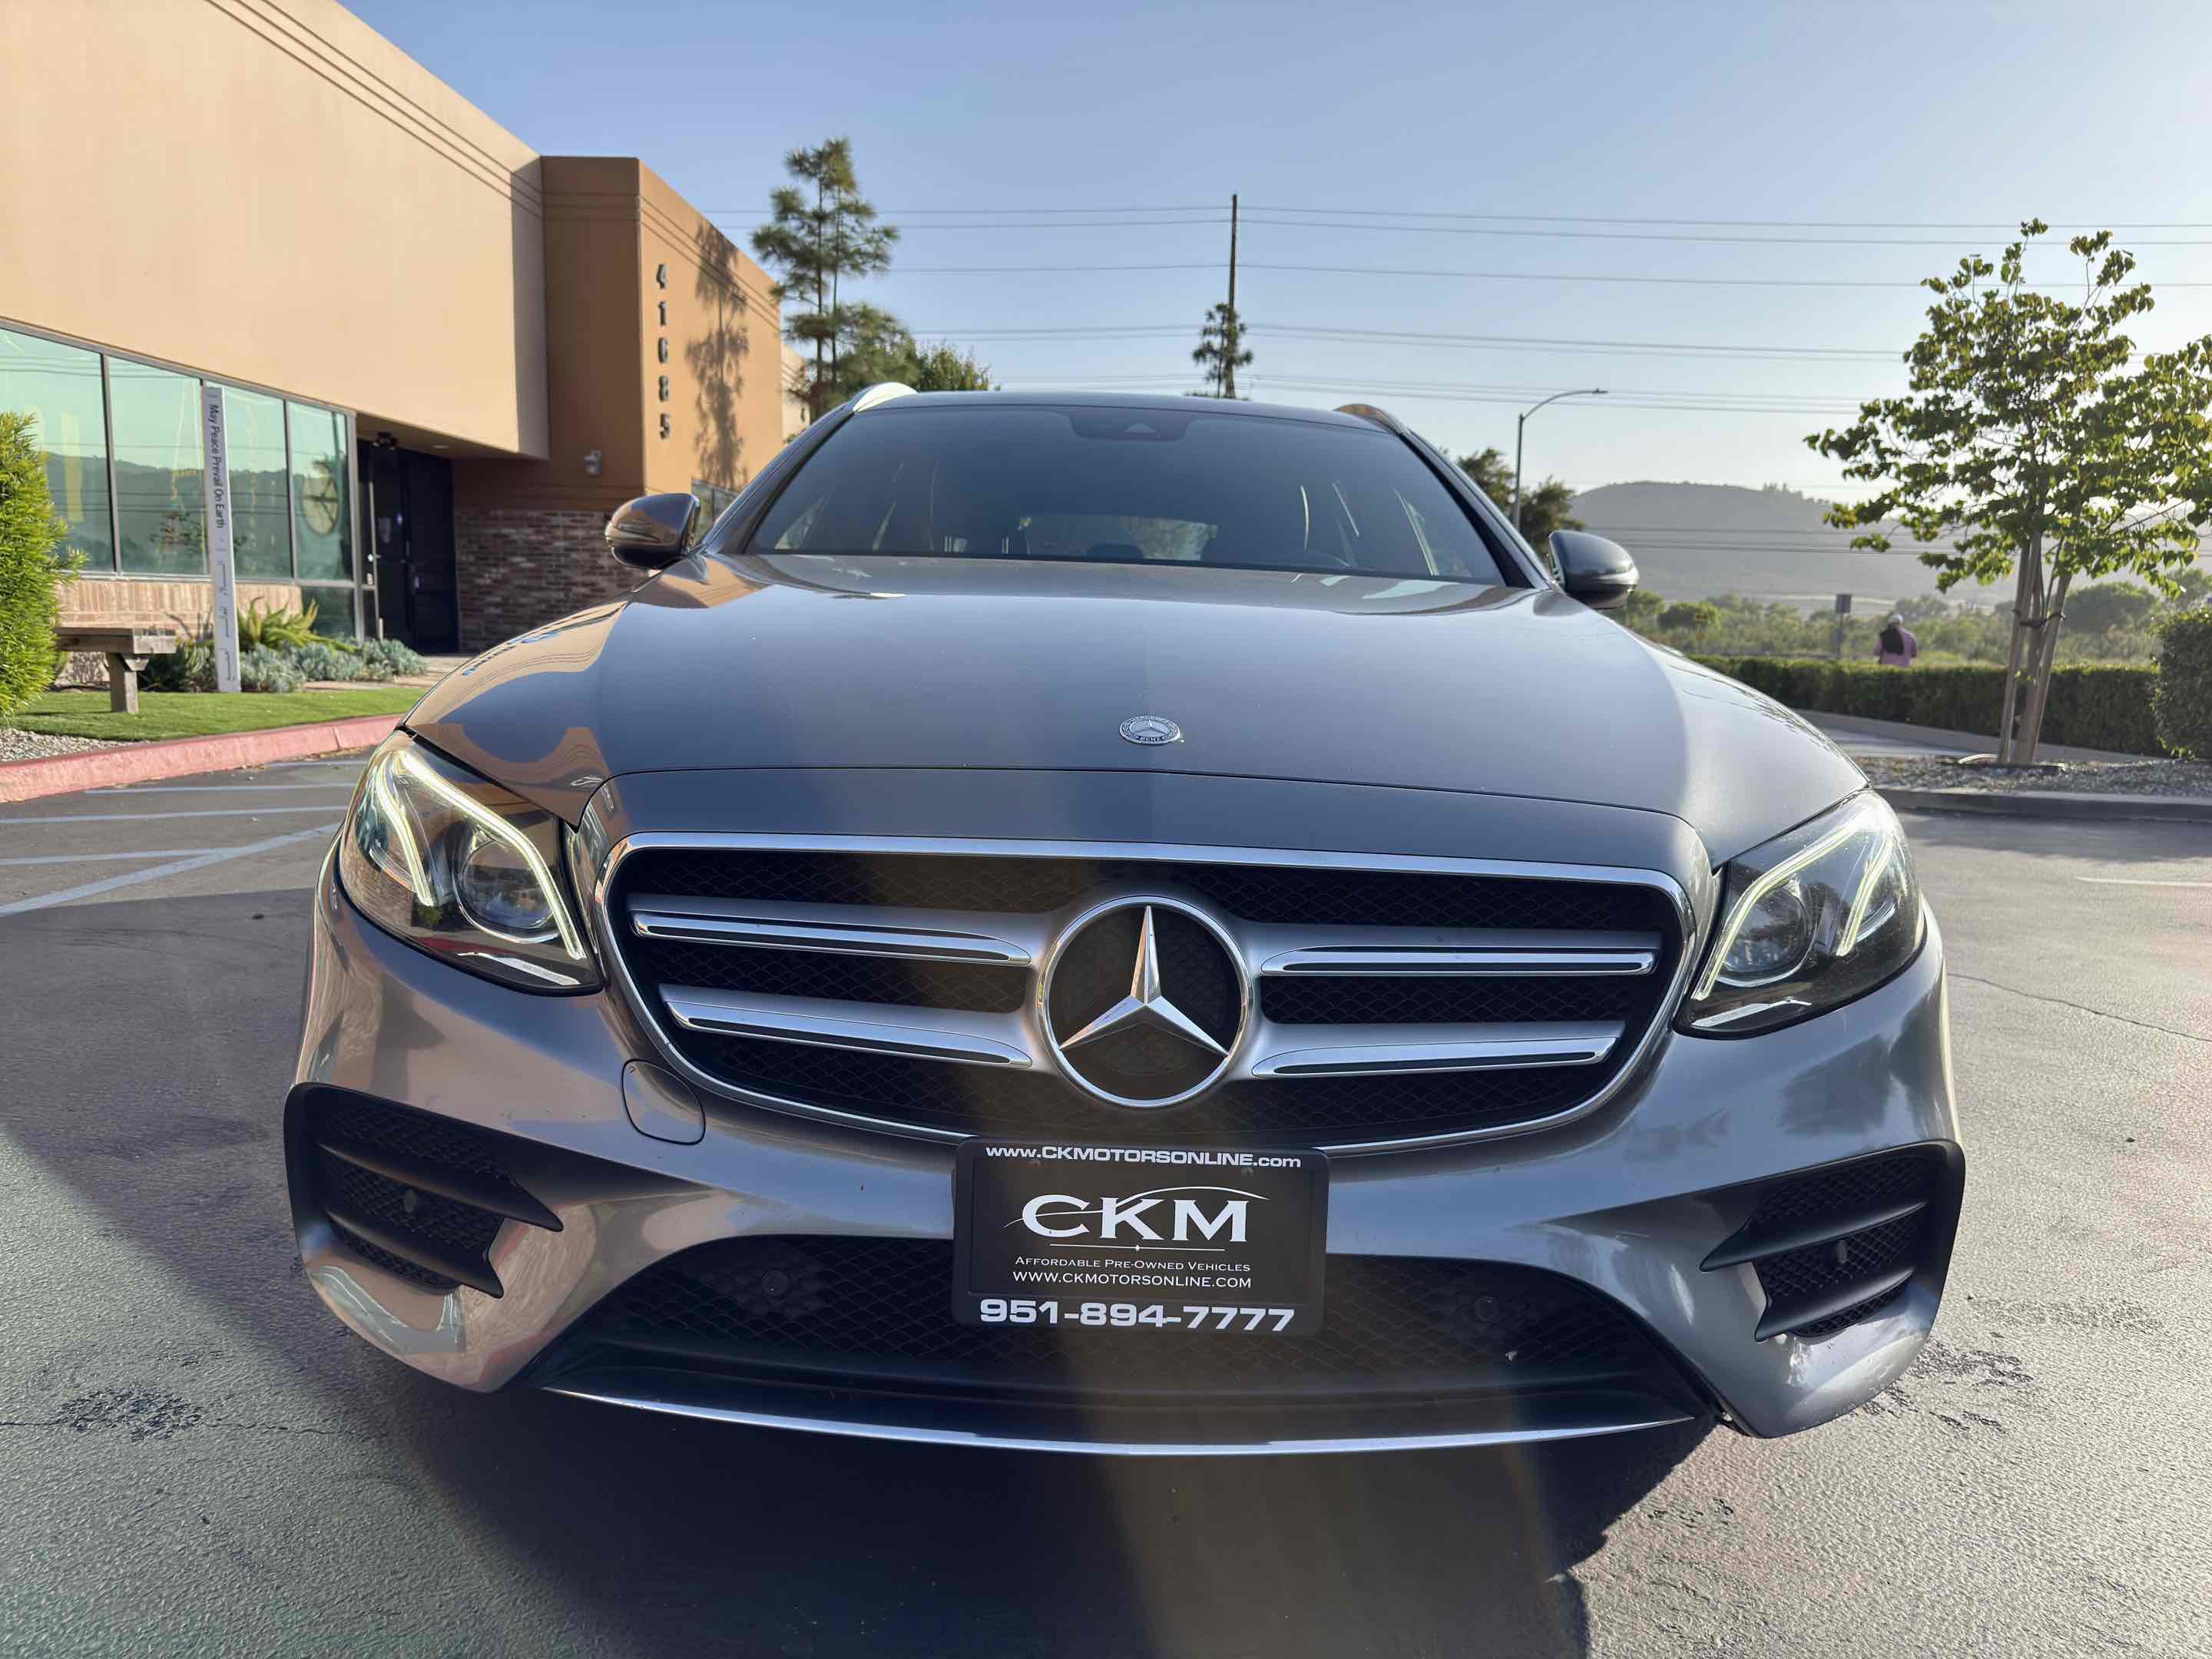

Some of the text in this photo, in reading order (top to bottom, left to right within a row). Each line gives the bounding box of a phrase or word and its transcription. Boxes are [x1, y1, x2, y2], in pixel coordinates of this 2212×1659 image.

[657, 263, 669, 439] 41685
[208, 405, 225, 528] May Peace Prevail On Earth
[986, 1146, 1301, 1167] www.CKMOTORSONLINE.com
[1022, 1194, 1249, 1242] CKM
[1013, 1271, 1252, 1289] WWW.CKMOTORSONLINE.COM
[1015, 1256, 1251, 1272] AFFORDABLE PRE-OWNED VEHICLES
[980, 1299, 1295, 1332] 951-894-7777
